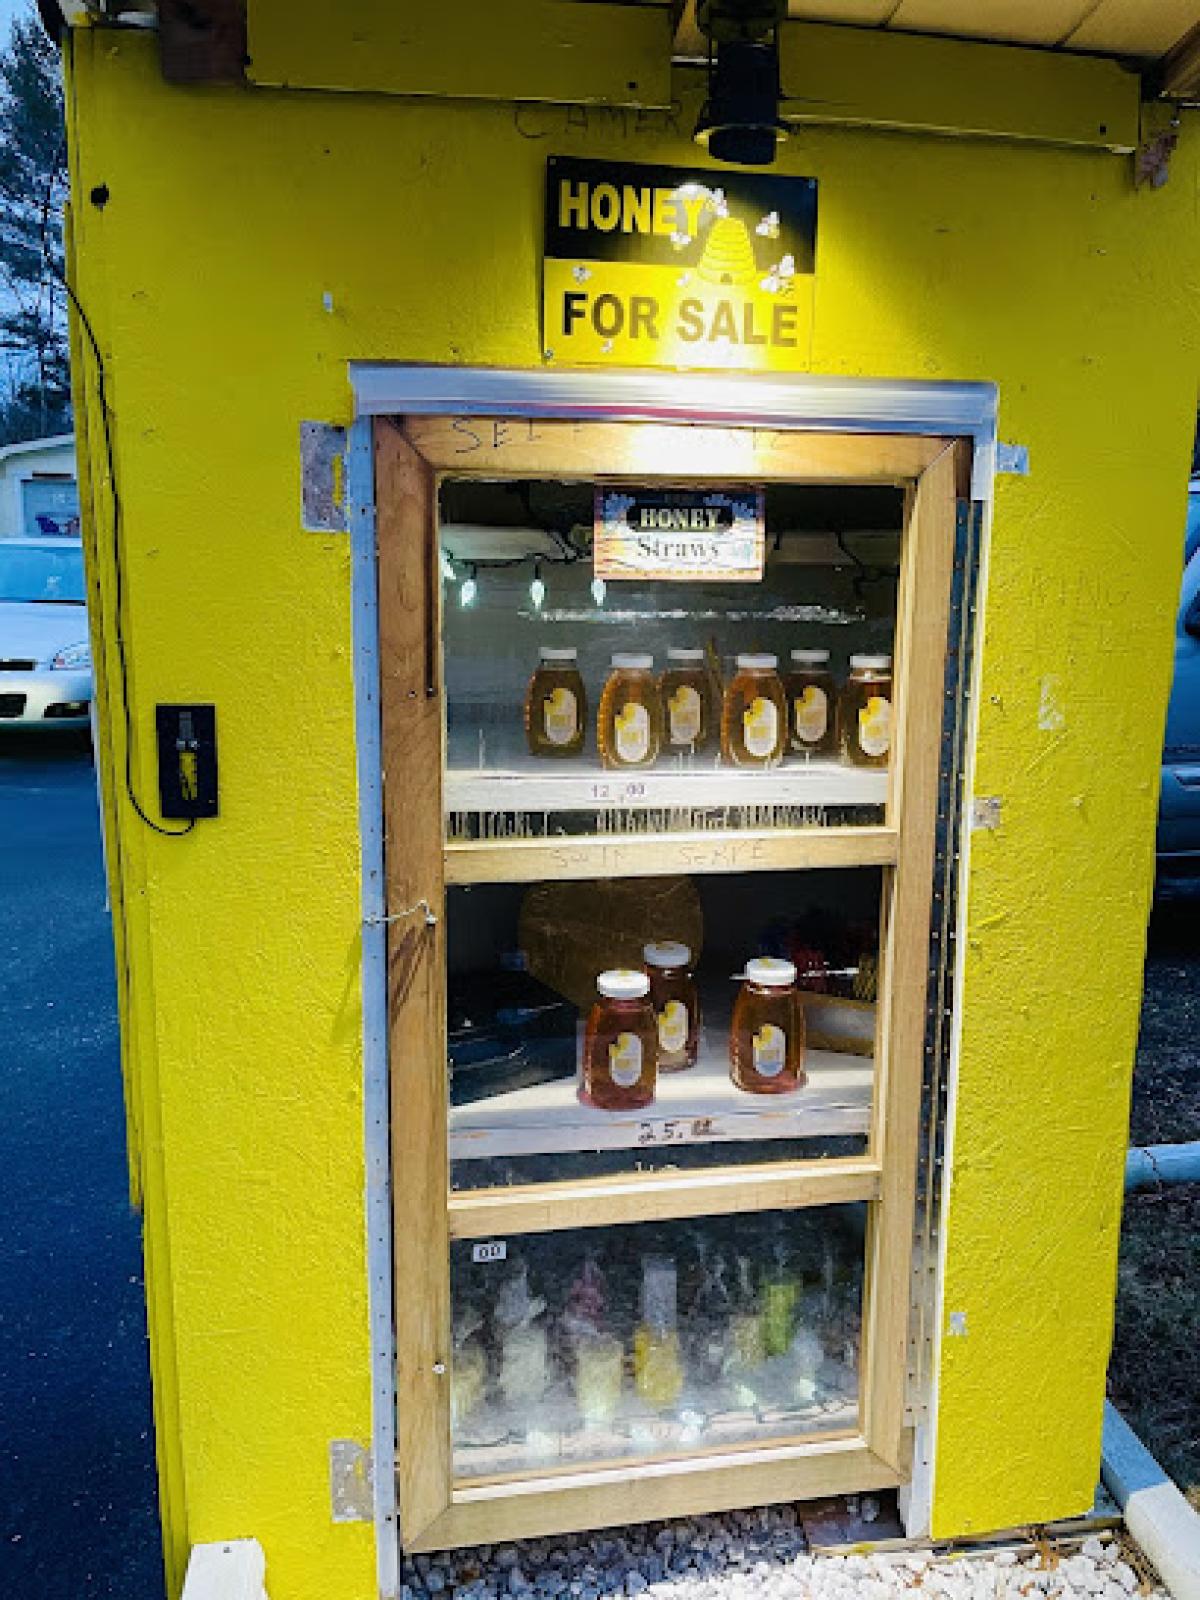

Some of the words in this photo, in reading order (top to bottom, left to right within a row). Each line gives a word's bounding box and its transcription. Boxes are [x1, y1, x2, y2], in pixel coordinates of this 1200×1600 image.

[558, 178, 706, 236] HONEY
[561, 290, 660, 339] FOR
[675, 298, 798, 348] SALE
[640, 507, 721, 529] HONEY
